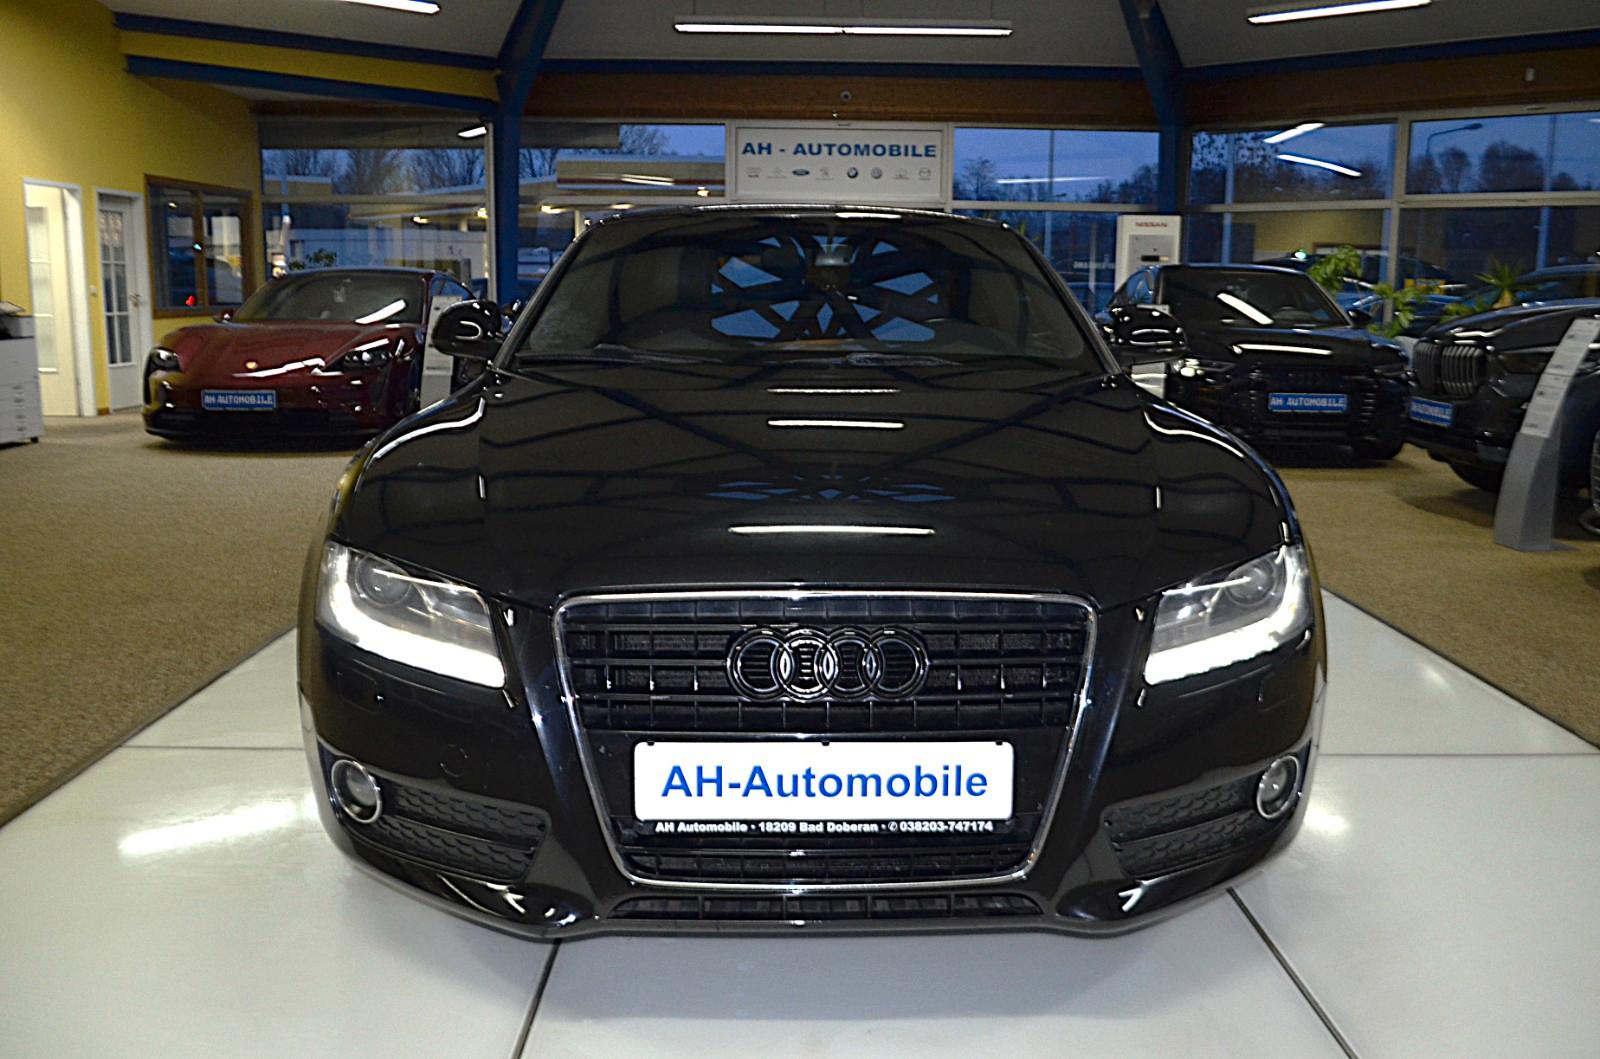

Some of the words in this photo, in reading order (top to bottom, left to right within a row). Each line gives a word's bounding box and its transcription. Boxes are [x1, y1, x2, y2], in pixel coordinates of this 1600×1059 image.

[741, 142, 773, 155] AH
[793, 143, 937, 157] AUTOMOBILE
[217, 394, 273, 405] AUTOMOBILE
[1286, 397, 1345, 407] AUTOMOBILE
[661, 765, 988, 797] AH-Automobile
[655, 821, 675, 833] AH
[677, 821, 748, 833] Automobile
[758, 821, 797, 832] 18209
[799, 821, 824, 832] Bad
[827, 821, 878, 833] Doberan
[899, 821, 994, 832] 038203-747174
